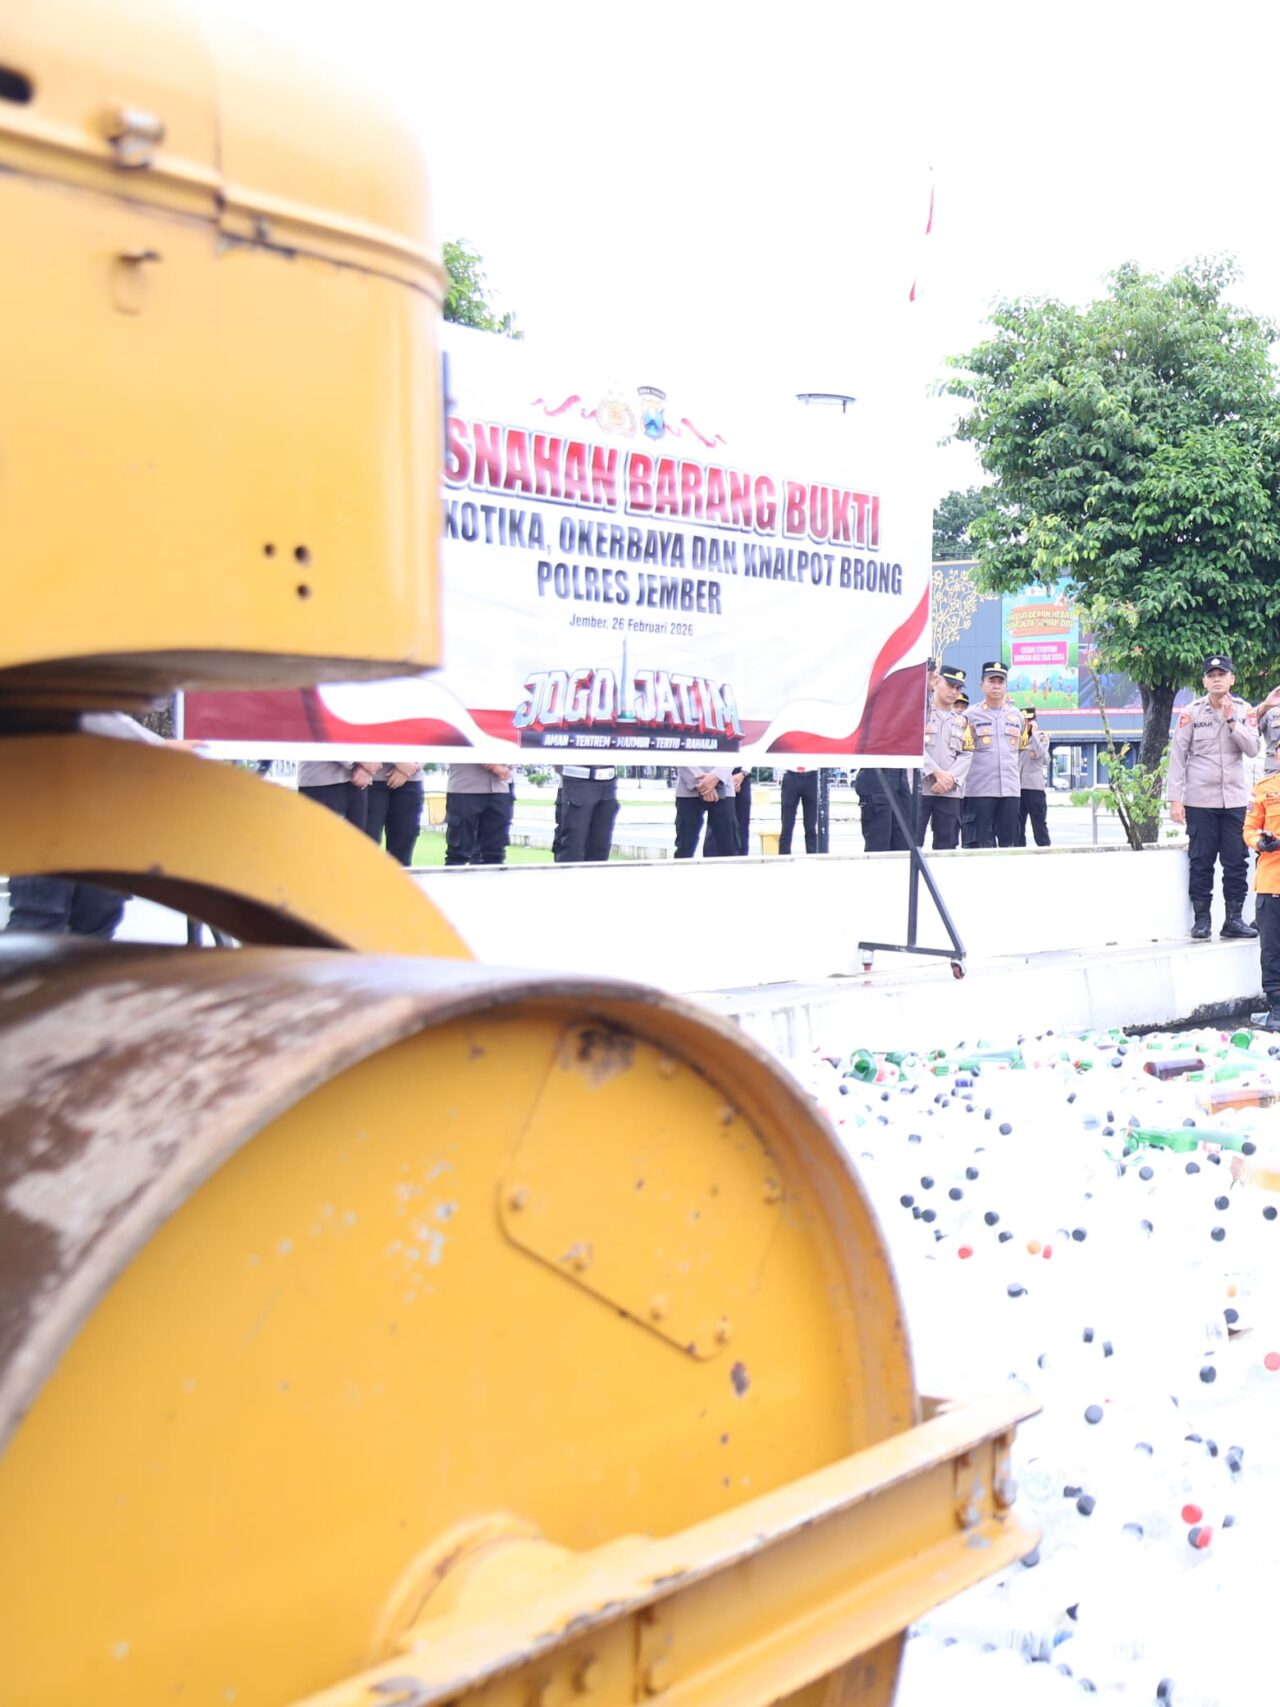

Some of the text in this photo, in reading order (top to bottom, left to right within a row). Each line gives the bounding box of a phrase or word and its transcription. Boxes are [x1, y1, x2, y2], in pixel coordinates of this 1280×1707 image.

[628, 452, 777, 532] BARANG
[785, 480, 880, 546] BUKTI
[537, 560, 722, 615] POLRES JEMBER
[559, 516, 686, 569] OKERBAYA
[691, 535, 738, 575] DAN
[743, 543, 836, 587] KNALPOT
[839, 556, 903, 596] BRONG
[612, 617, 625, 631] 26
[628, 618, 668, 635] Februari
[670, 622, 694, 637] 2026
[512, 668, 744, 739] JOGO JATIM
[544, 734, 569, 747] AMAN
[575, 735, 611, 748] TENTREM
[616, 736, 651, 748] MAKMUR
[656, 737, 681, 749] TERTIB
[685, 738, 718, 750] RAHARJA
